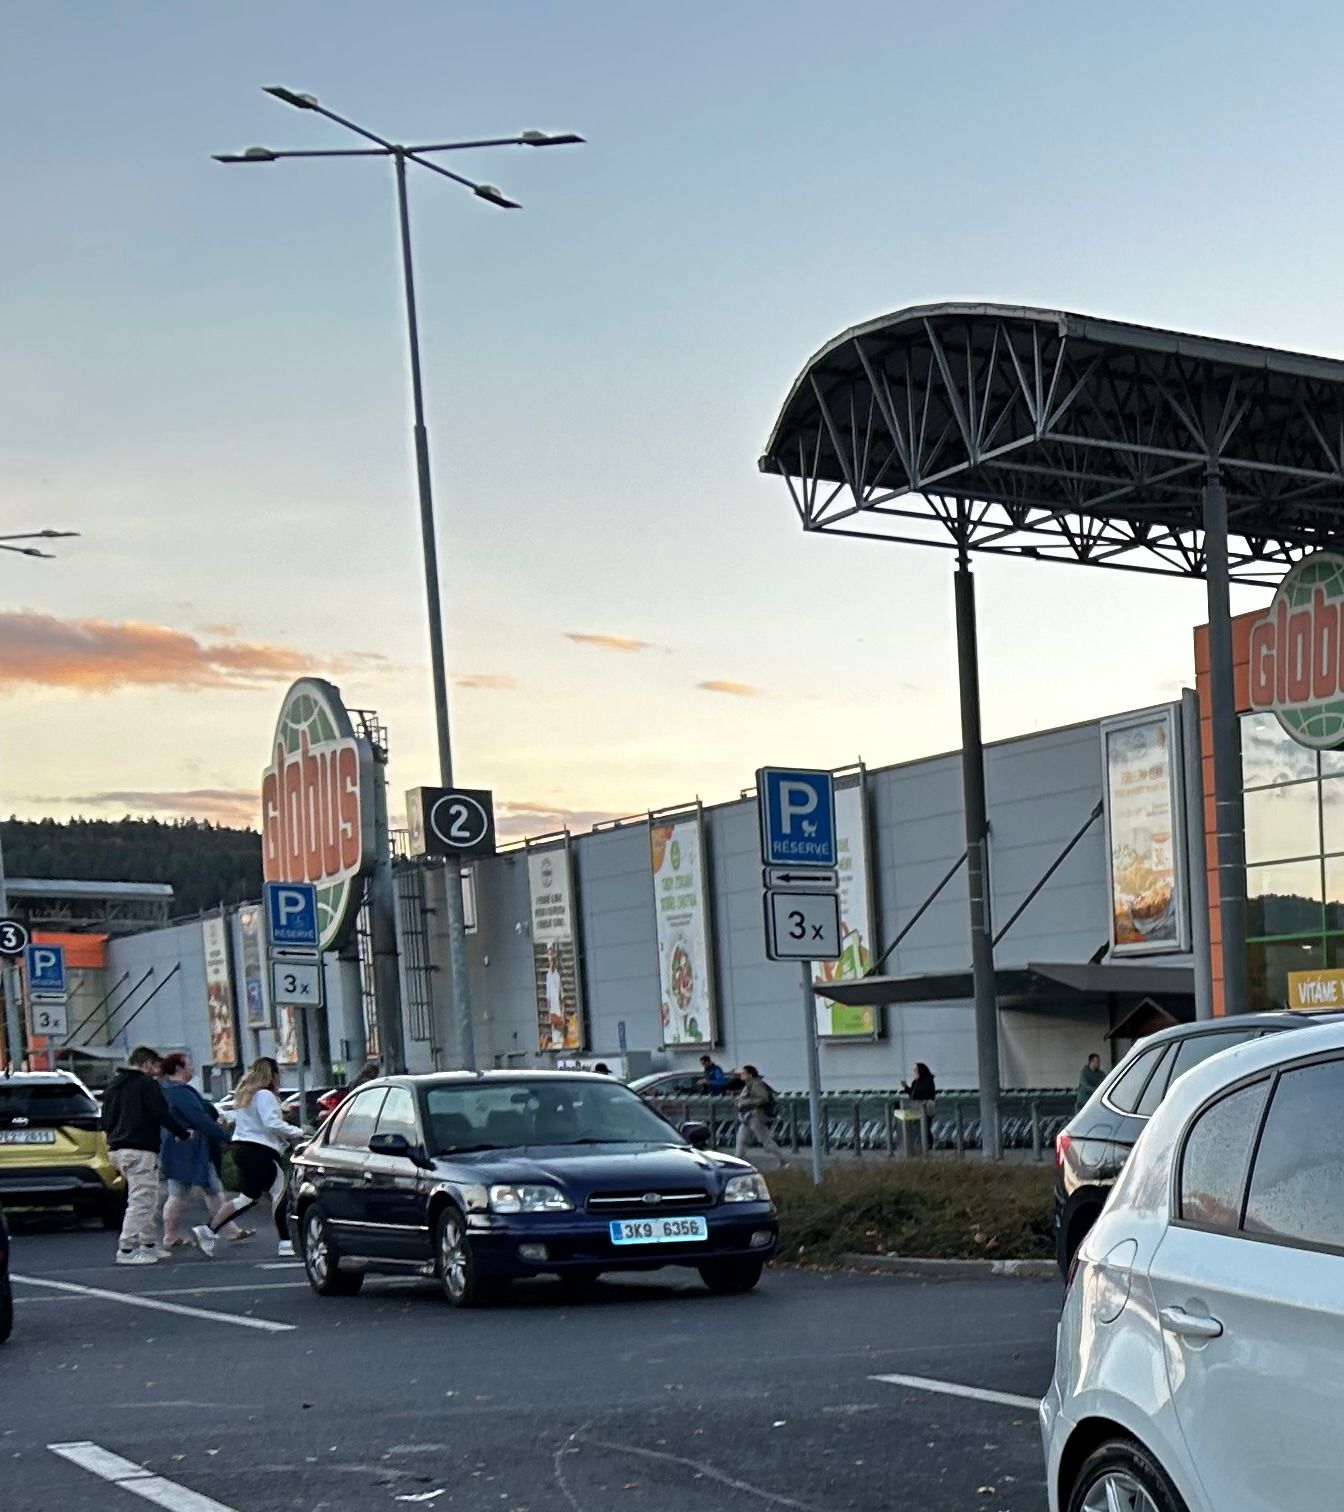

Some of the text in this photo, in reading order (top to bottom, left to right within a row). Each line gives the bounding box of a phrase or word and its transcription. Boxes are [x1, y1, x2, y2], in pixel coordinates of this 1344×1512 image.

[449, 804, 470, 838] 2
[779, 780, 818, 835] P
[278, 889, 306, 926] P
[2, 926, 17, 948] 3
[34, 950, 56, 977] P
[1298, 976, 1338, 1003] VÍTÁME
[624, 1220, 700, 1239] 3K9 6356
